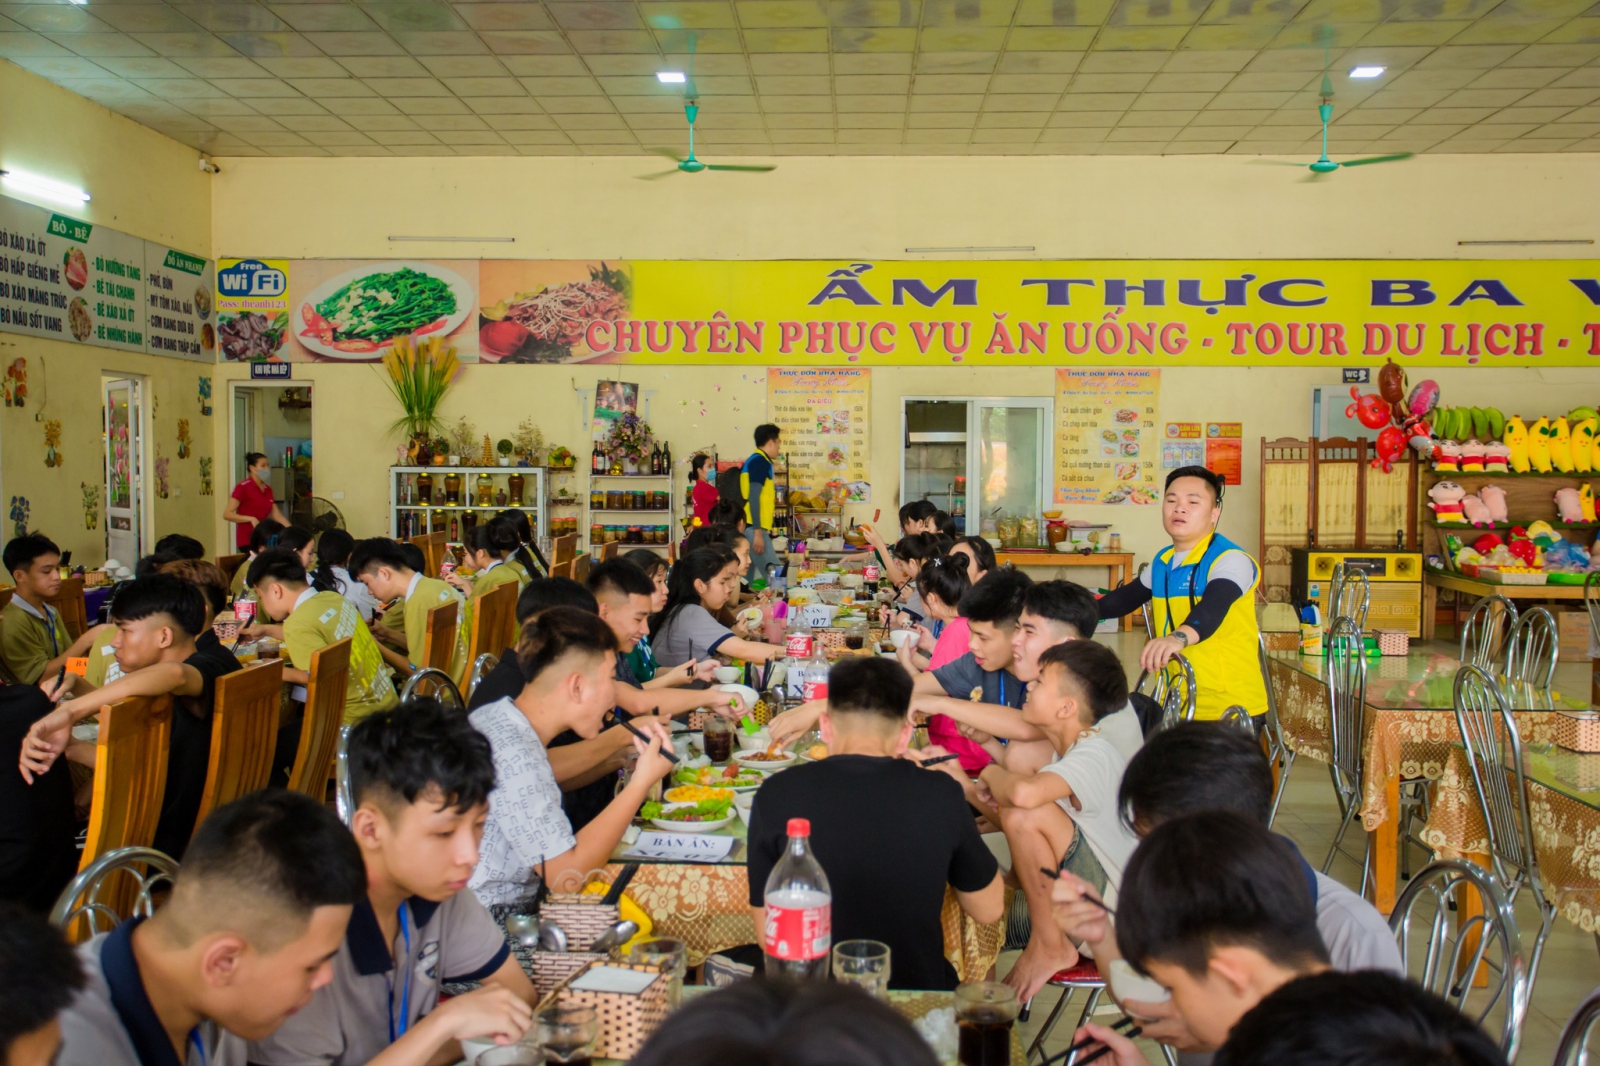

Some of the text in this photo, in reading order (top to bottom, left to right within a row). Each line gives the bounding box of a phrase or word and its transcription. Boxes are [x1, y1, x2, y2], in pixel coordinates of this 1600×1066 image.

[240, 262, 263, 271] Free
[806, 263, 1526, 315] ẨM THỰC BA
[585, 310, 765, 354] CHUYÊN
[778, 320, 898, 362] PHỤC
[909, 320, 973, 362] VỤ
[984, 311, 1048, 355] ĂN
[1063, 307, 1190, 356] UỐNG
[1225, 322, 1349, 356] TOUR
[1362, 322, 1427, 356] DU
[1439, 322, 1545, 365] LỊCH
[1345, 370, 1358, 378] WC
[812, 617, 827, 626] 07
[653, 835, 685, 847] BÀN
